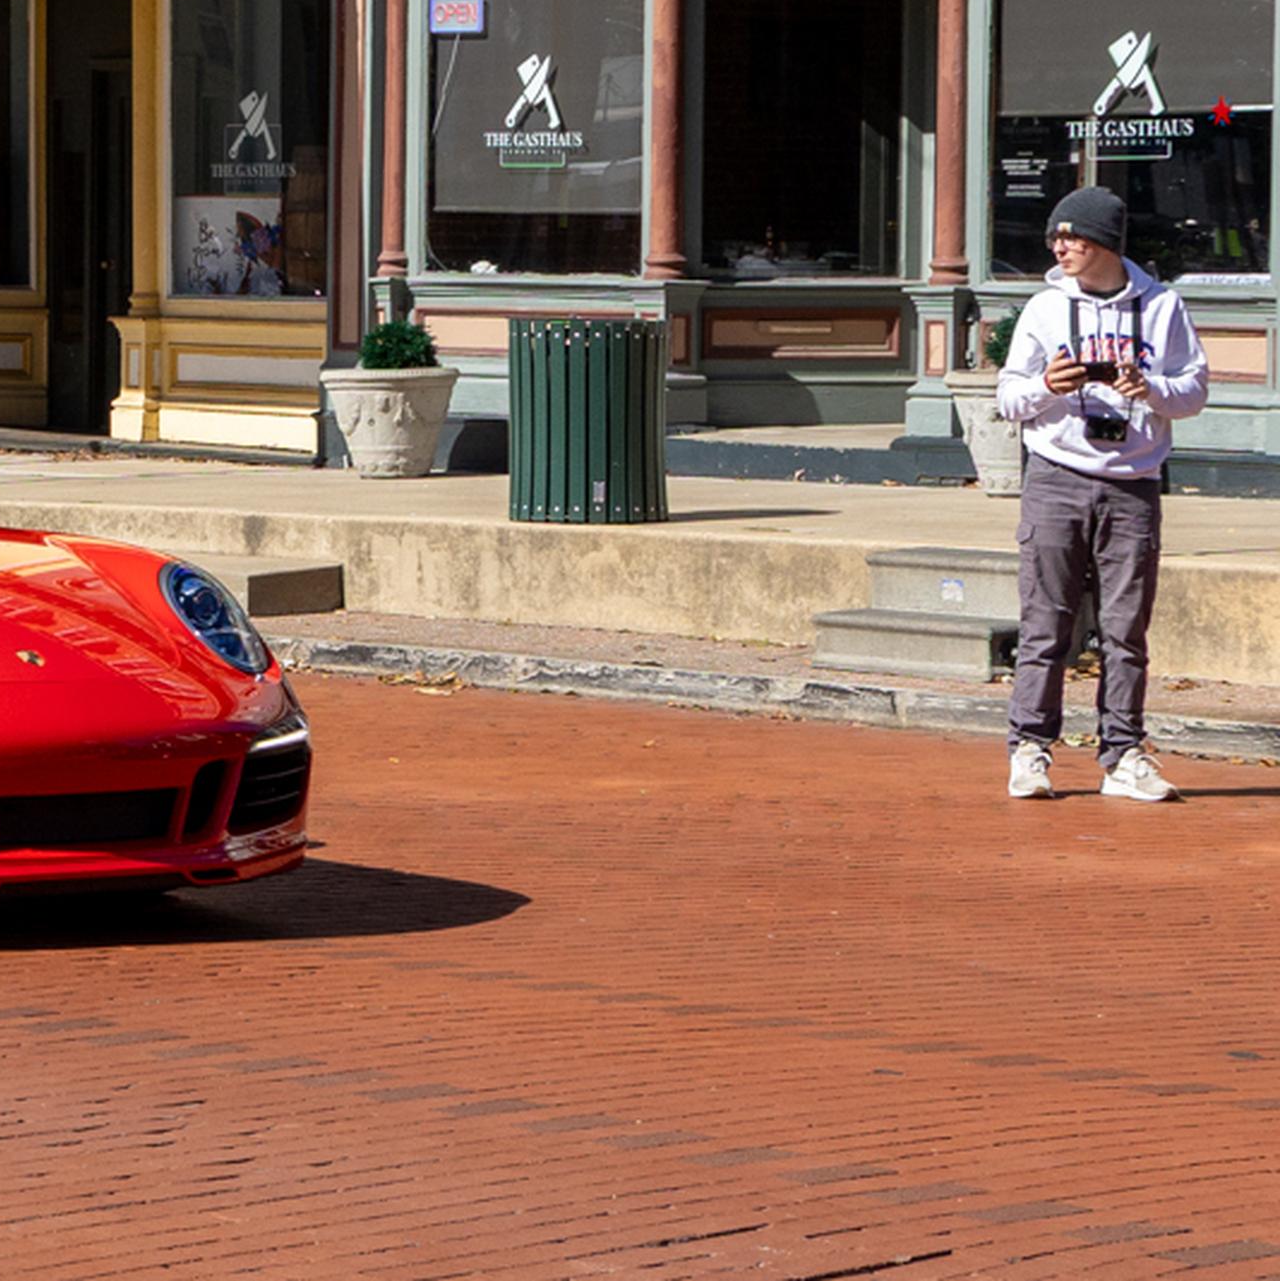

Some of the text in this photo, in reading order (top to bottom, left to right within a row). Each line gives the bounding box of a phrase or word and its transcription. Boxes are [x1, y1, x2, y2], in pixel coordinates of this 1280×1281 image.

[434, 3, 478, 24] OPEN
[1065, 121, 1102, 138] THE
[1103, 118, 1194, 137] GASTHAUS
[483, 131, 584, 148] THE GASTHAUS
[210, 162, 297, 178] THE GASTHAUS
